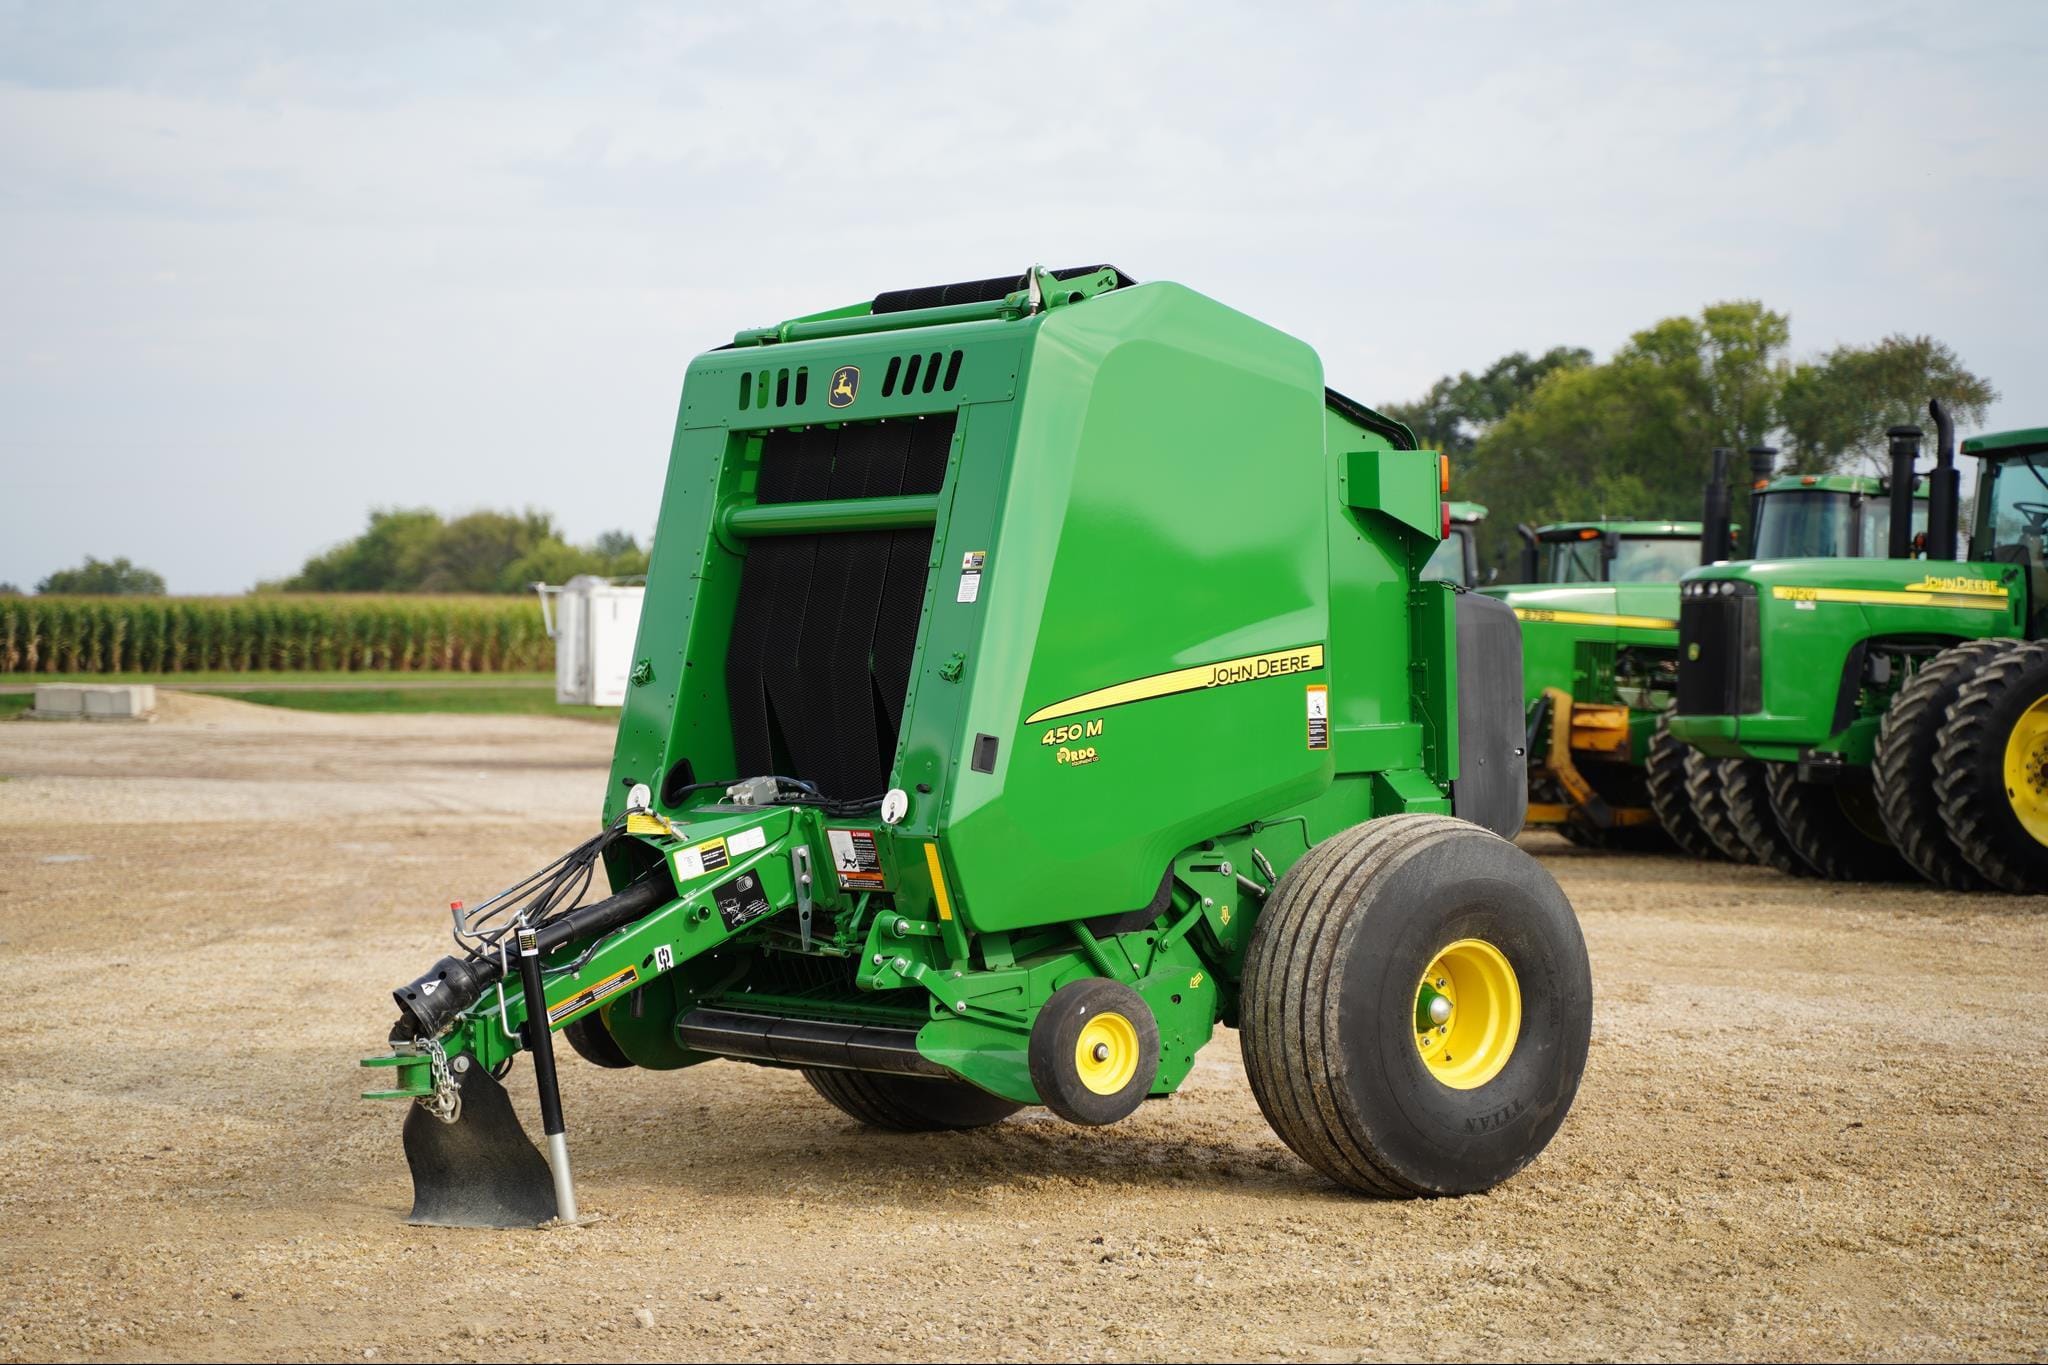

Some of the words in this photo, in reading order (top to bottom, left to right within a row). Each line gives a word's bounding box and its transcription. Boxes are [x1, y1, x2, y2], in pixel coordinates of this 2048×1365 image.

[1925, 574, 1955, 590] JOHN
[1957, 576, 1999, 592] DEERE
[1208, 664, 1252, 685] JOHN
[1257, 655, 1310, 676] DEERE
[1041, 723, 1083, 746] 450
[1085, 718, 1104, 738] M
[1070, 747, 1096, 762] RDO
[1465, 1098, 1525, 1132] TITAN
